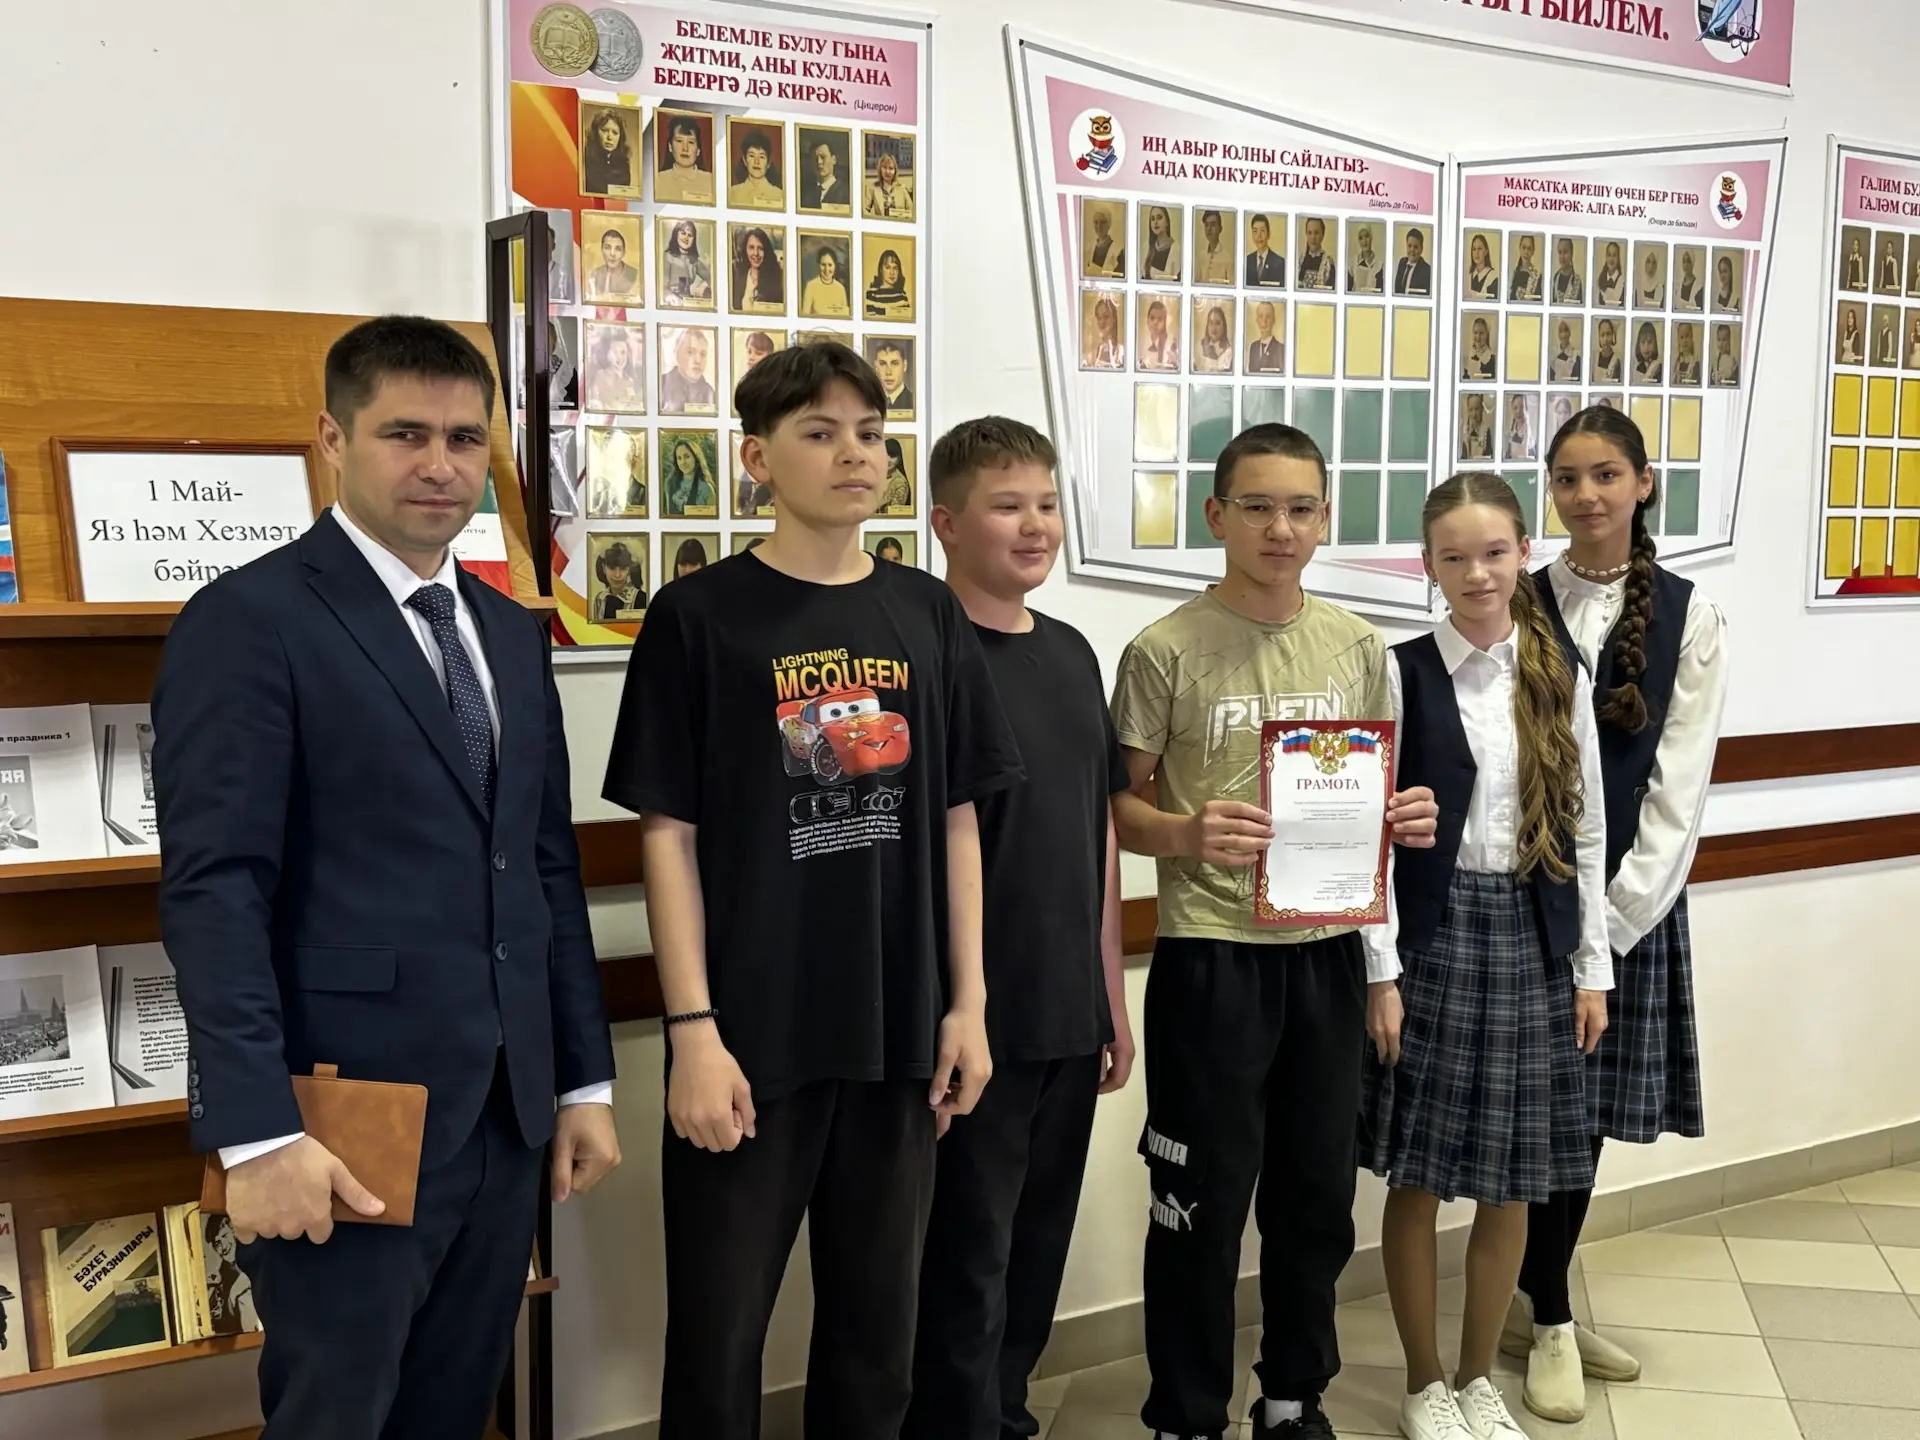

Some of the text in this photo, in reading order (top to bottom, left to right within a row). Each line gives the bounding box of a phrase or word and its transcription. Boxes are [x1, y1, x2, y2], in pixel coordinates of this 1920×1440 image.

[675, 20, 888, 64] БЕЛЕМЛЕ БУЛУ ГЫНА
[660, 42, 892, 88] ҖИТМИ, АНЫ КУЛЛАНА
[654, 67, 848, 107] БЕЛЕРГӘ ДӘ КИРӘК.
[853, 99, 898, 115] (Цицерон)
[1142, 136, 1369, 174] ИҢ АВЫР ЮЛНЫ САЙЛАГЫЗ-
[1142, 159, 1389, 198] АНДА КОНКУРЕНТЛАР БУЛМАС.
[1504, 177, 1569, 195] МАКСАТКА
[1615, 185, 1647, 201] ӨЧЕН
[1649, 189, 1669, 204] БЕР
[1671, 191, 1700, 206] ГЕНӘ
[1860, 175, 1902, 195] ГАЛИМ
[1498, 194, 1647, 219] НӘРСӘ КИРӘК: АЛГА БАРУ.
[1860, 195, 1900, 214] ГАЛӘМ
[149, 478, 244, 503] 1 Май-
[89, 518, 299, 542] Яз һәм Хезмәт
[154, 558, 240, 584] бәйр
[772, 648, 849, 670] LIGHTNING
[774, 658, 909, 701] MCQUEEN
[7, 734, 62, 743] праздника
[1296, 778, 1360, 791] ГРАМОТА
[73, 1249, 108, 1283] БӘХЕТ
[82, 1225, 154, 1292] БУРАЗНАЛАРЫ
